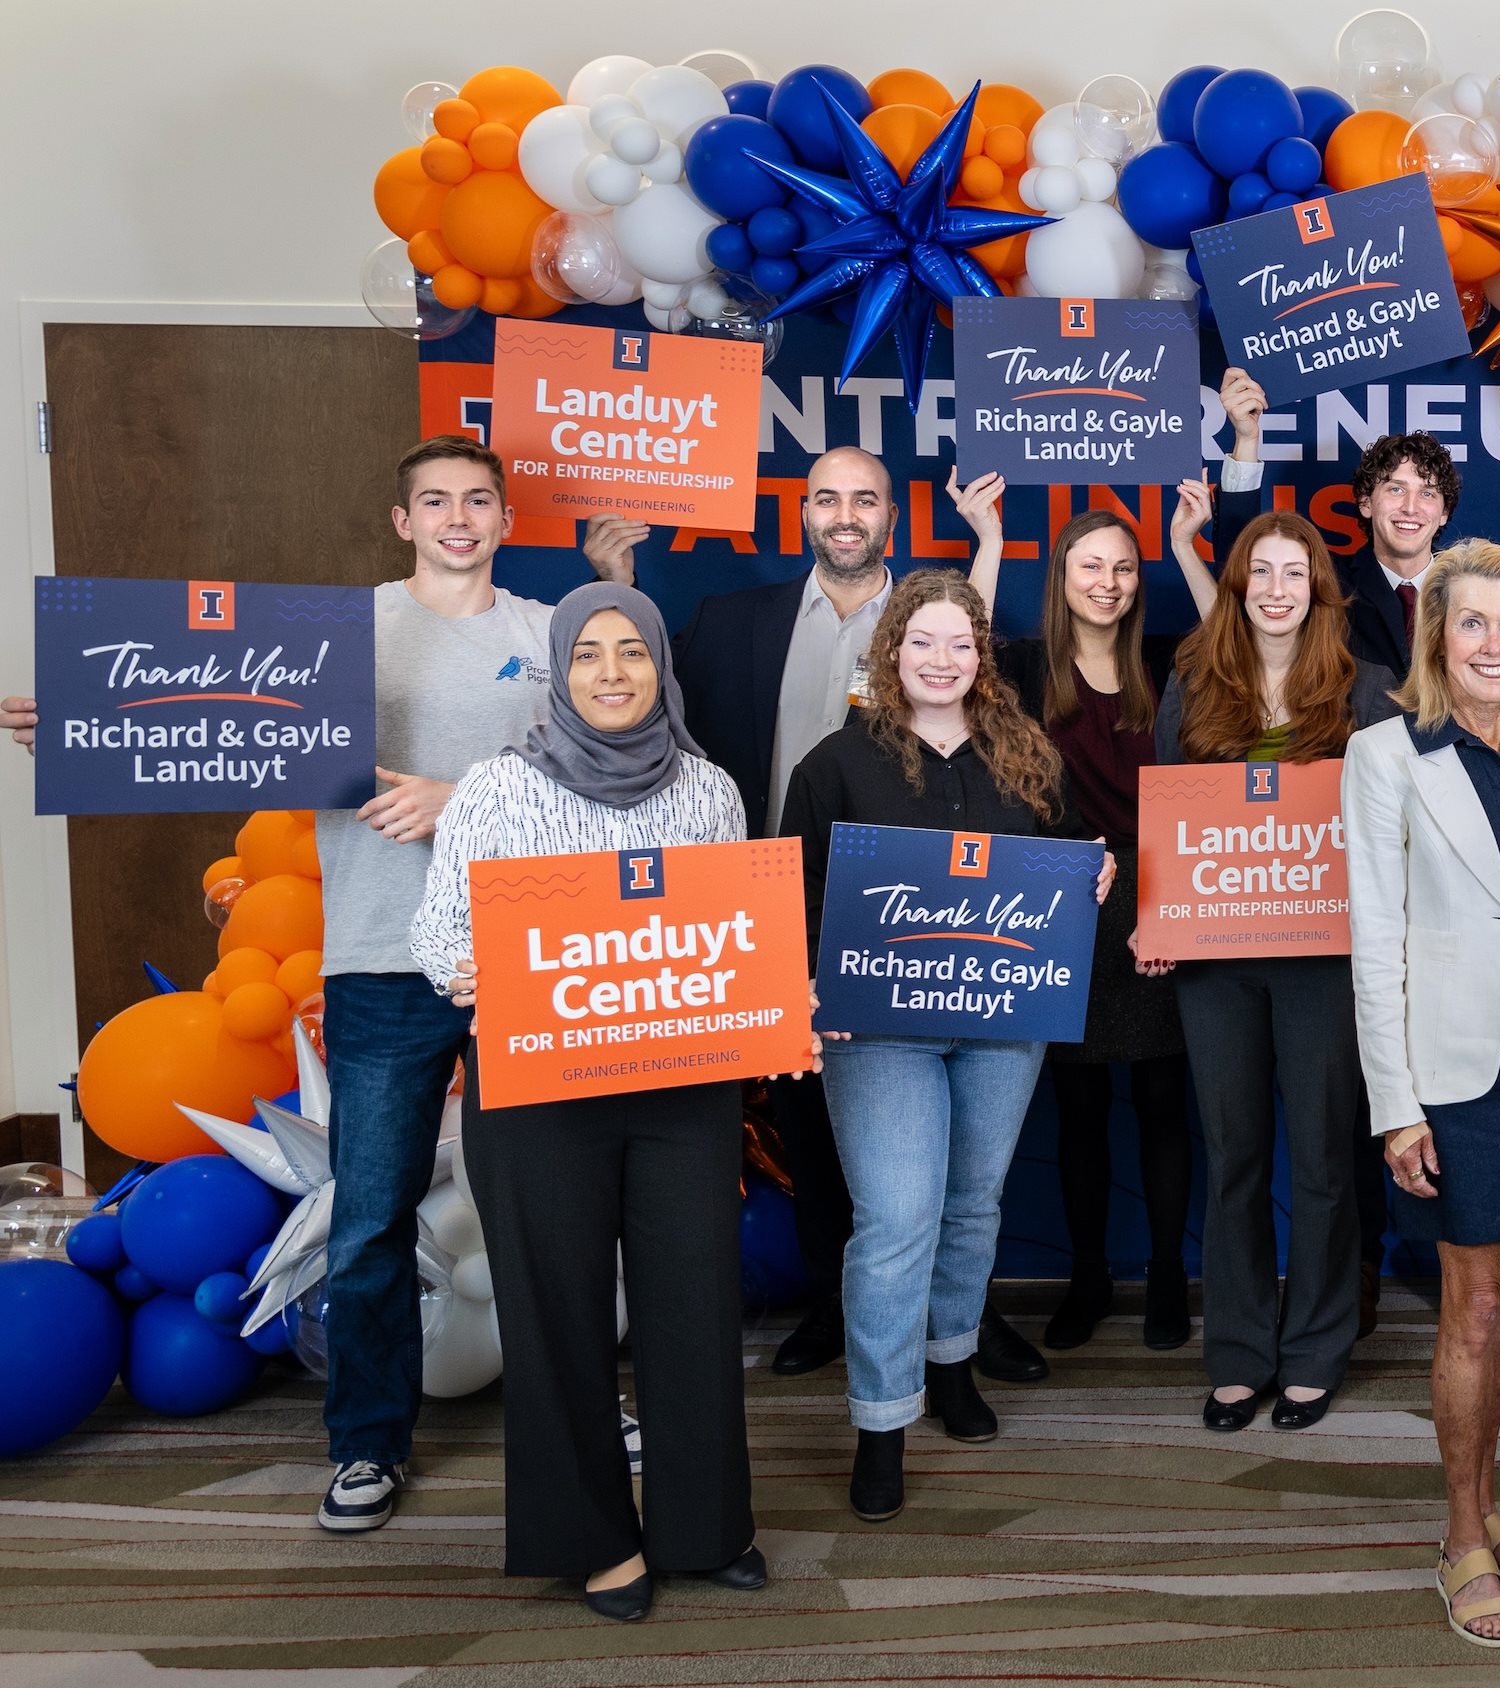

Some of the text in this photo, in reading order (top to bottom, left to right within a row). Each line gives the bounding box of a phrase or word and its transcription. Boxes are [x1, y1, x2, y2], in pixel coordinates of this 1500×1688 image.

[1237, 225, 1405, 306] Thank You!
[1242, 288, 1441, 360] Richard & Gayle
[986, 344, 1166, 391] Thank You!
[1295, 326, 1403, 374] Landuyt
[535, 378, 718, 433] Landuyt
[975, 407, 1183, 439] Richard & Gayle
[550, 420, 699, 465] Center
[1024, 436, 1136, 466] Landuyt
[513, 459, 735, 490] FOR ENTREPRENEURSHIP
[552, 493, 696, 514] GRAINGER ENGINEERING
[82, 640, 330, 696] Thank You!
[64, 717, 352, 754] Richard & Gayle
[134, 752, 287, 789] Landuyt
[1177, 815, 1346, 860] Landuyt
[1192, 858, 1330, 896] Center
[862, 883, 1063, 937] Thank You!
[1159, 898, 1349, 919] FOR ENTREPRENEURSH
[527, 910, 756, 972] Landuyt
[1195, 930, 1330, 945] GRAINGER ENGINEERING
[839, 949, 1071, 991] Richard & Gayle
[551, 966, 737, 1020] Center
[890, 983, 1015, 1019] Landuyt
[508, 1006, 784, 1055] FOR ENTREPRENEURSHIP
[562, 1049, 740, 1081] GRAINGER ENGINEERING
